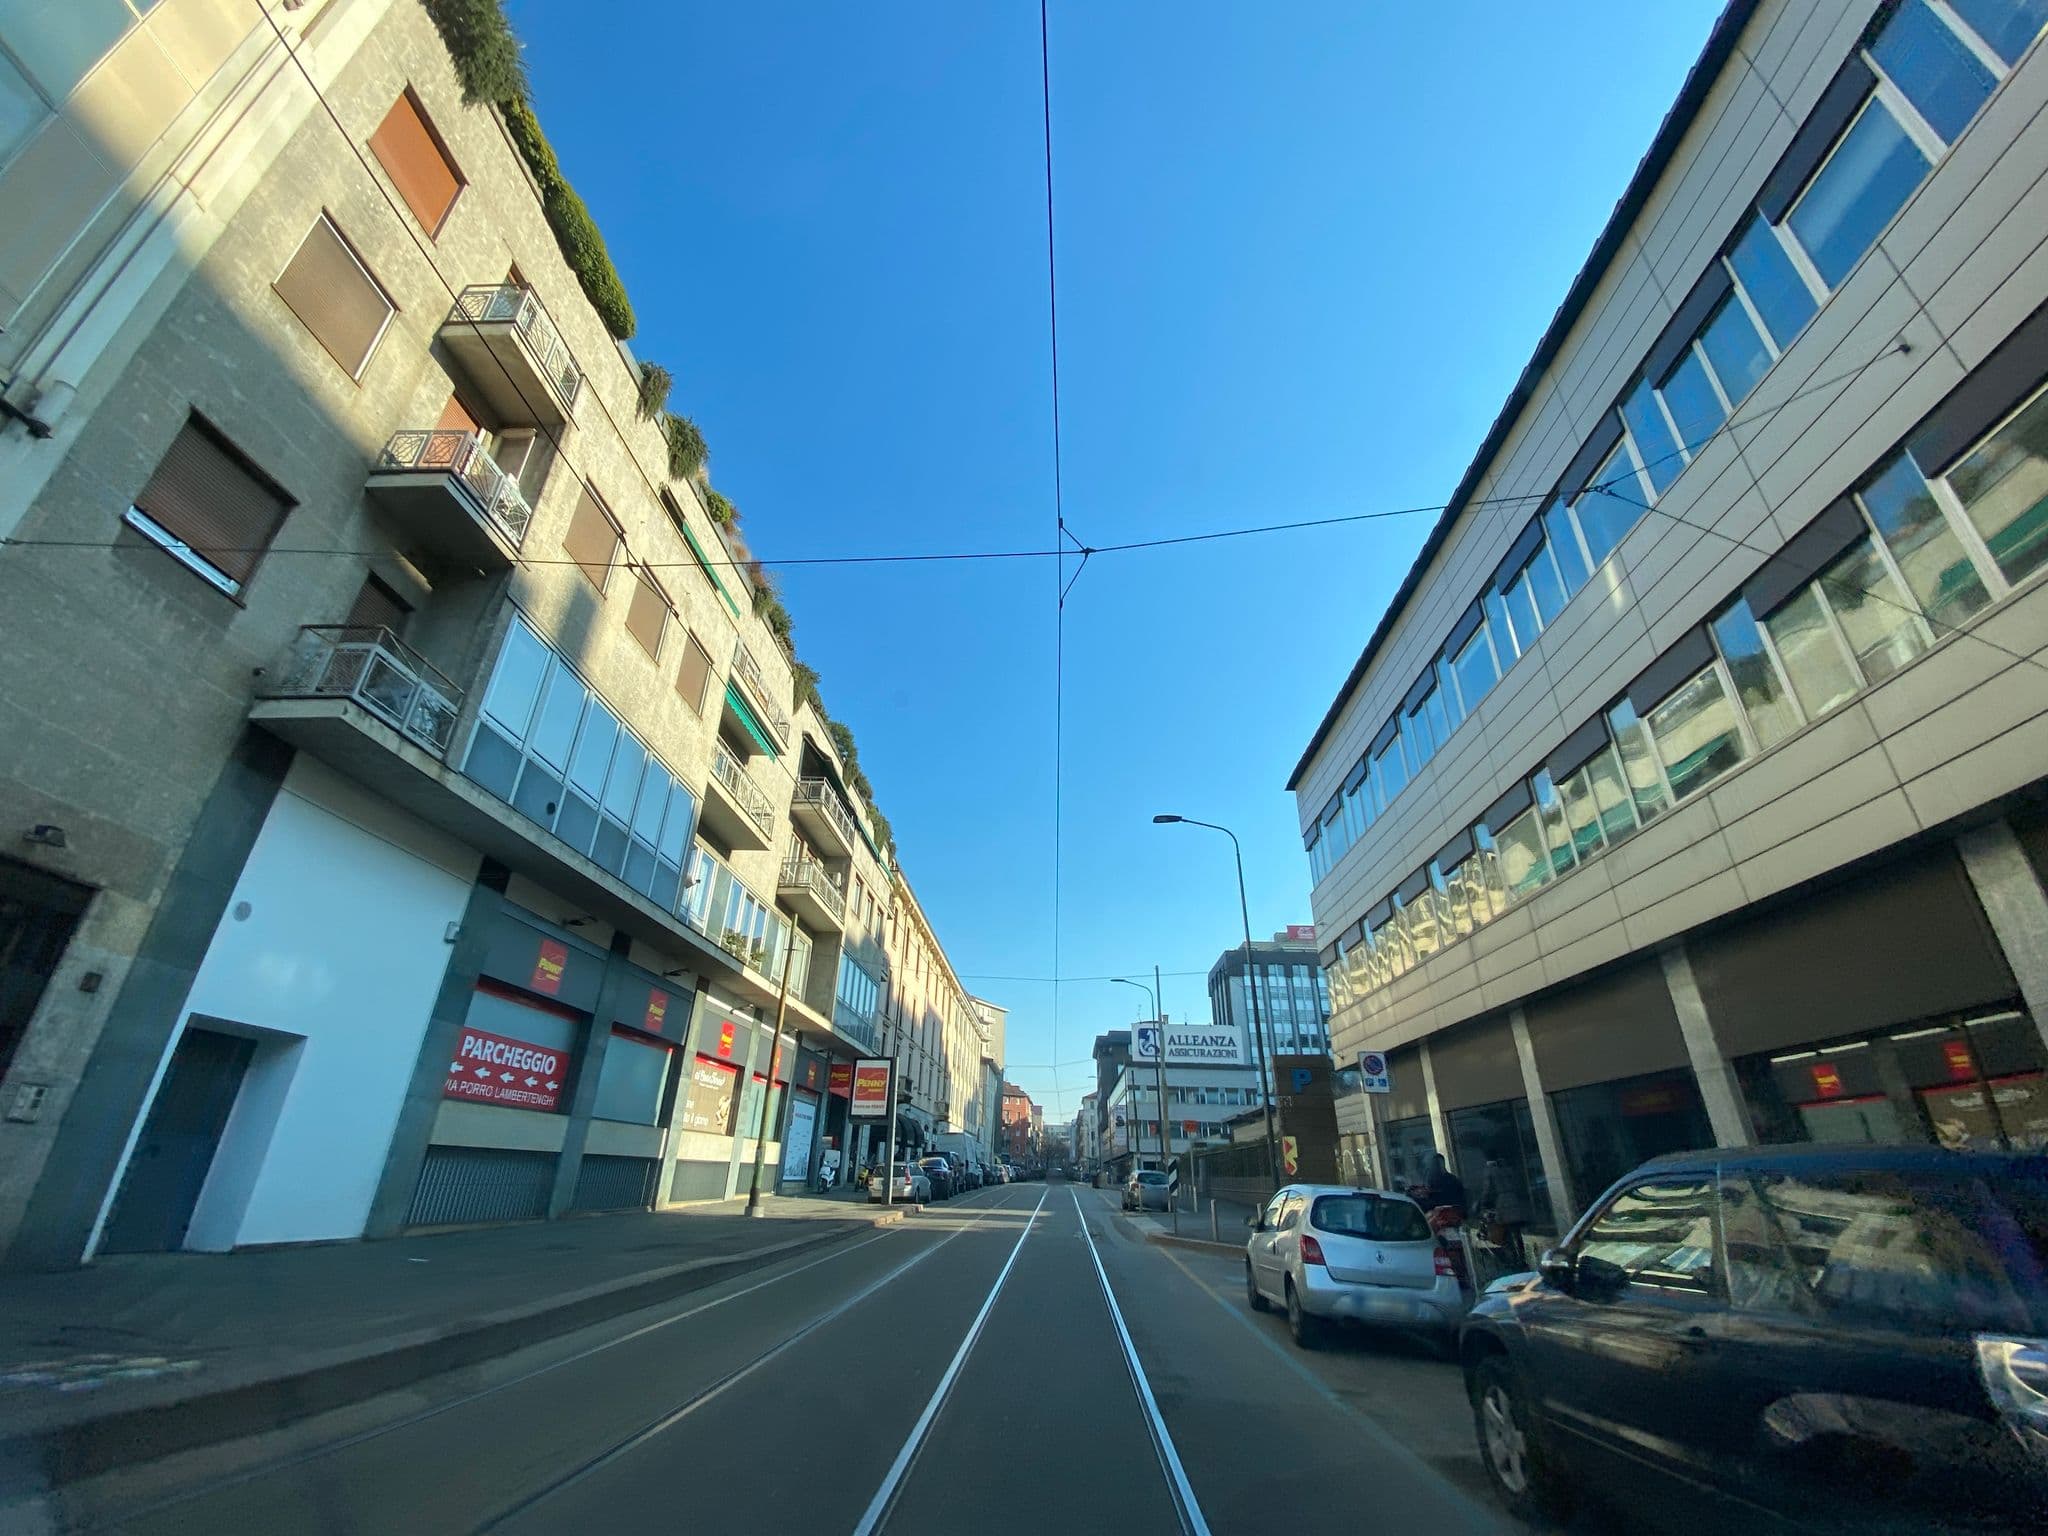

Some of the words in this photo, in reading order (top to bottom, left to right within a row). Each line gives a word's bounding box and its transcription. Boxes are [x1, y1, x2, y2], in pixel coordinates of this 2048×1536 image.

[1168, 1035, 1237, 1047] ALLEANZA
[461, 1035, 557, 1076] PARCHEGGIO
[1168, 1048, 1238, 1059] ASSICURAZIONI
[857, 1079, 885, 1088] PENNY
[1291, 1068, 1313, 1095] P
[459, 1081, 494, 1097] PORRO
